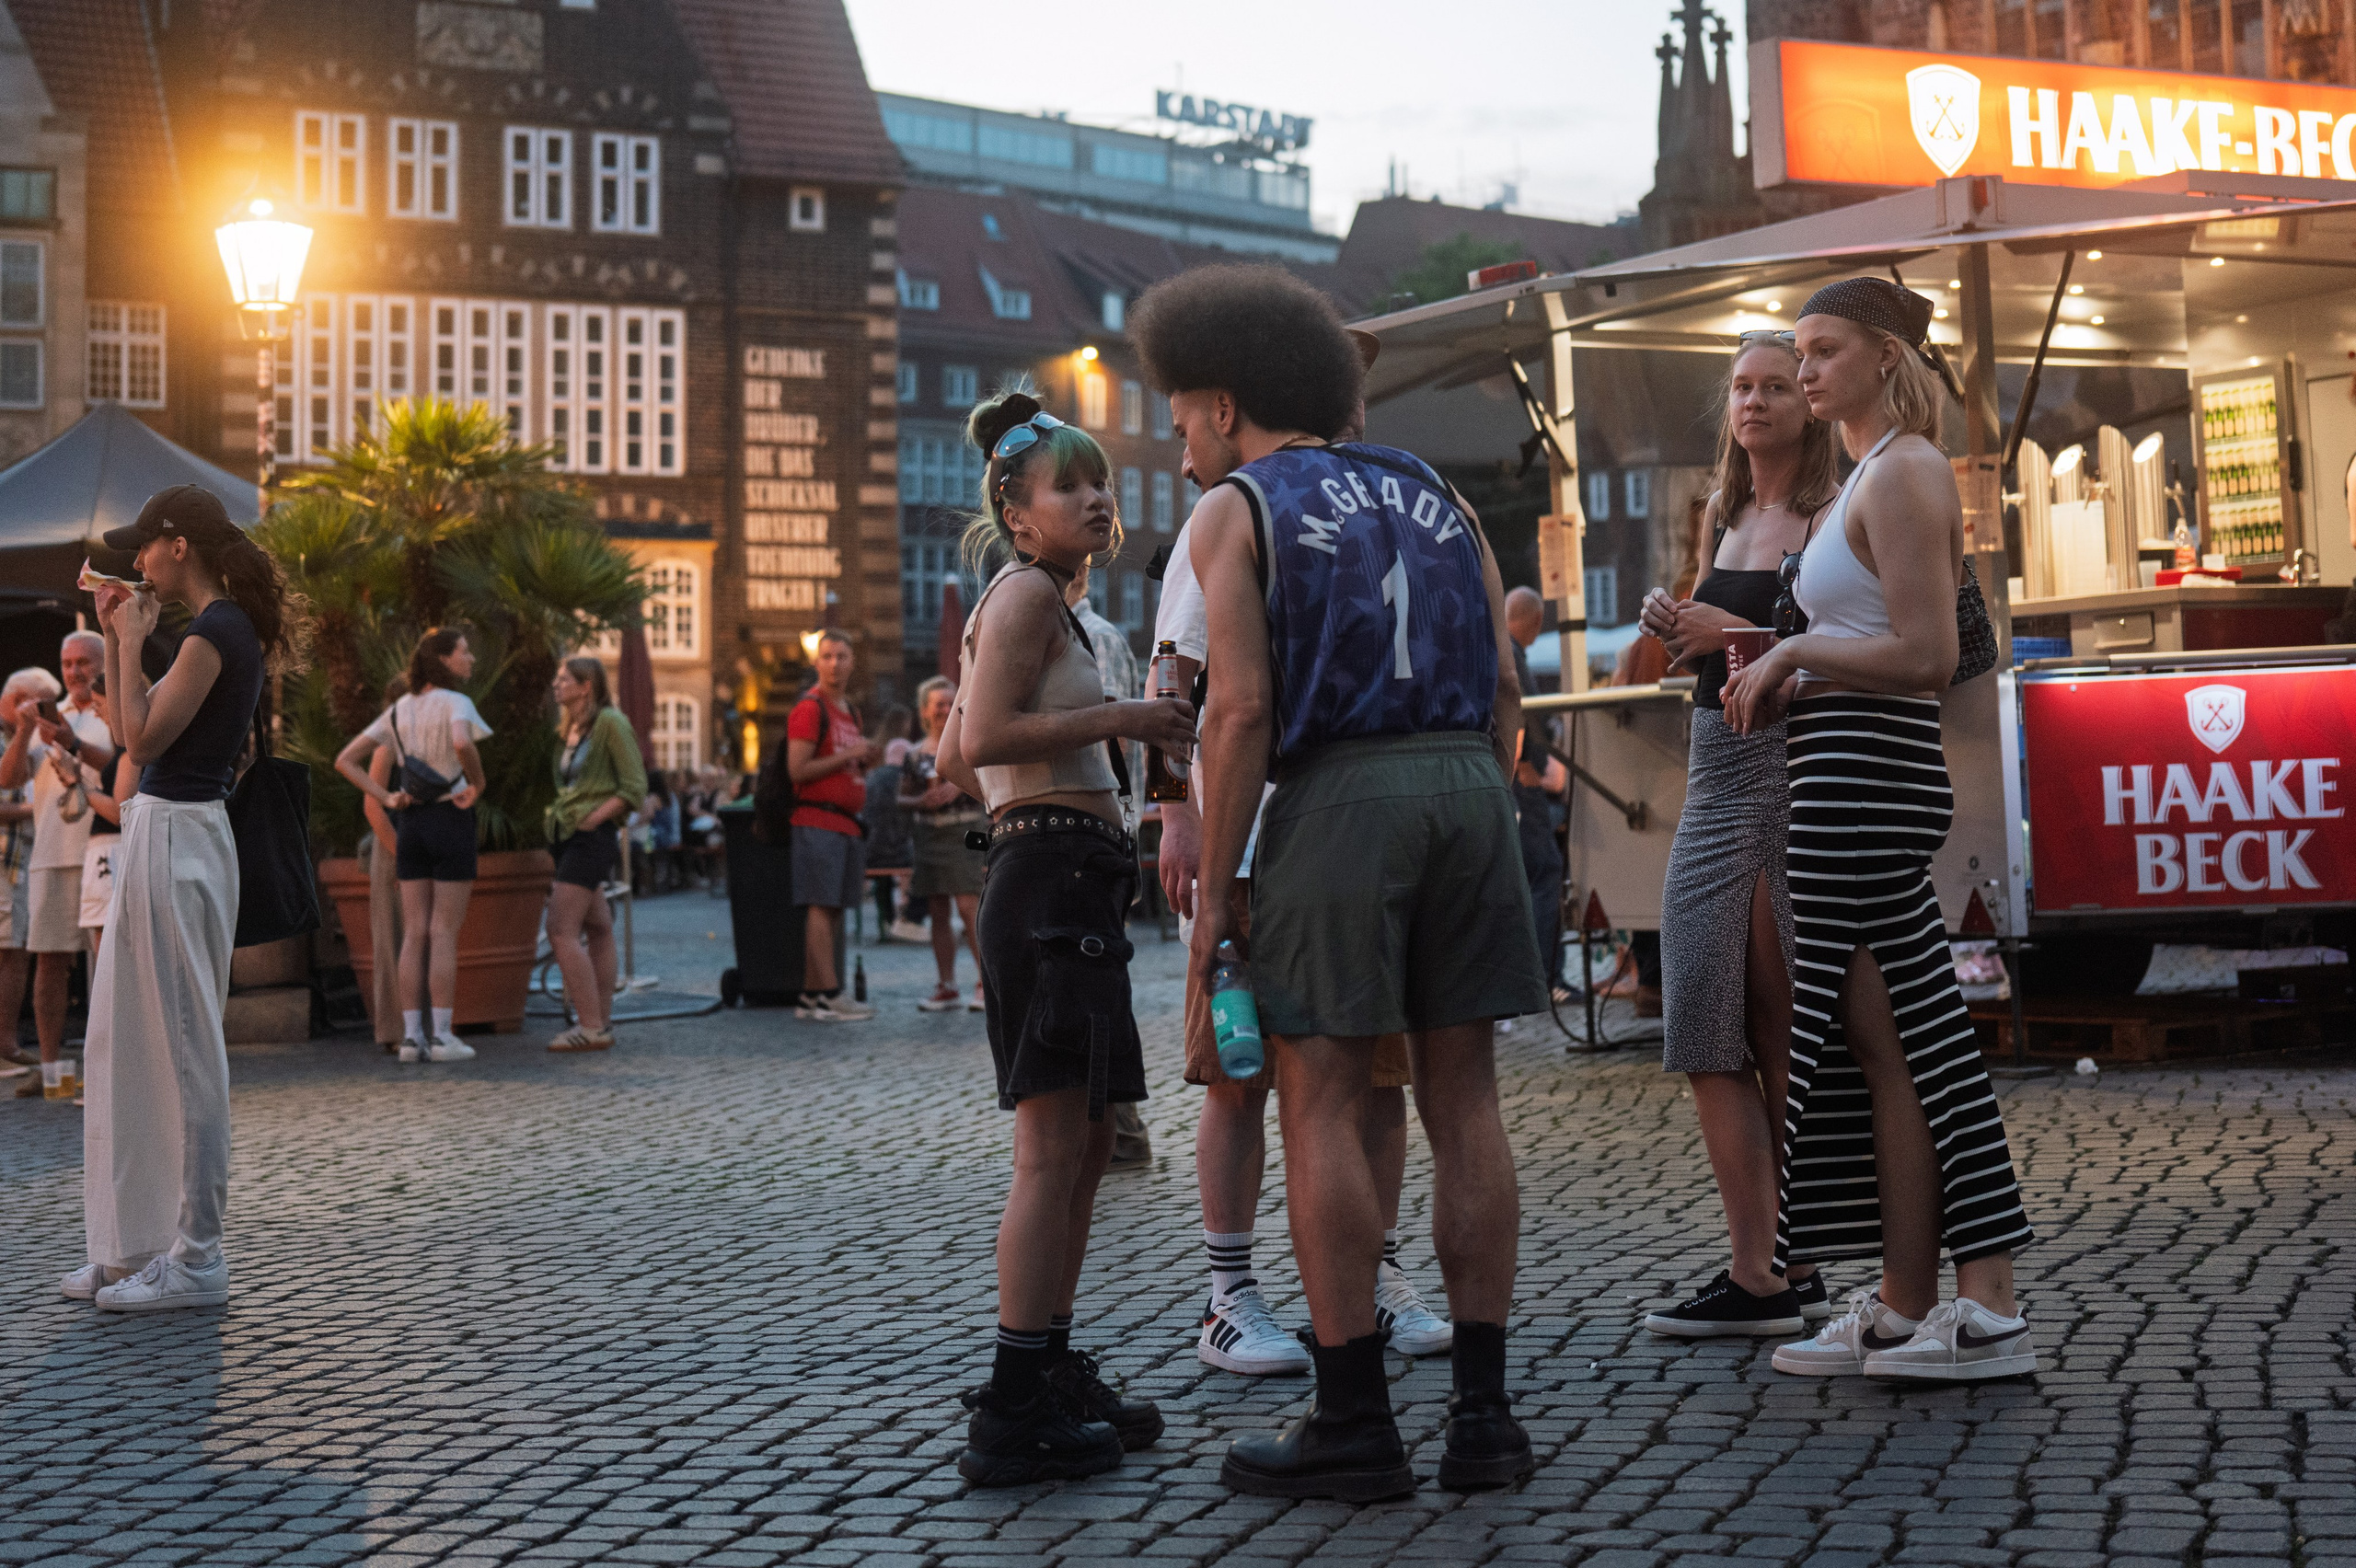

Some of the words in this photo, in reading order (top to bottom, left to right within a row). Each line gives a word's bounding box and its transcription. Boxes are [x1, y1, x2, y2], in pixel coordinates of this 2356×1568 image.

[1380, 548, 1414, 679] 1
[1727, 644, 1738, 677] OSTA
[2101, 757, 2346, 825] HAAKE
[2134, 829, 2323, 894] BECK
[1233, 1290, 1258, 1302] adidas
